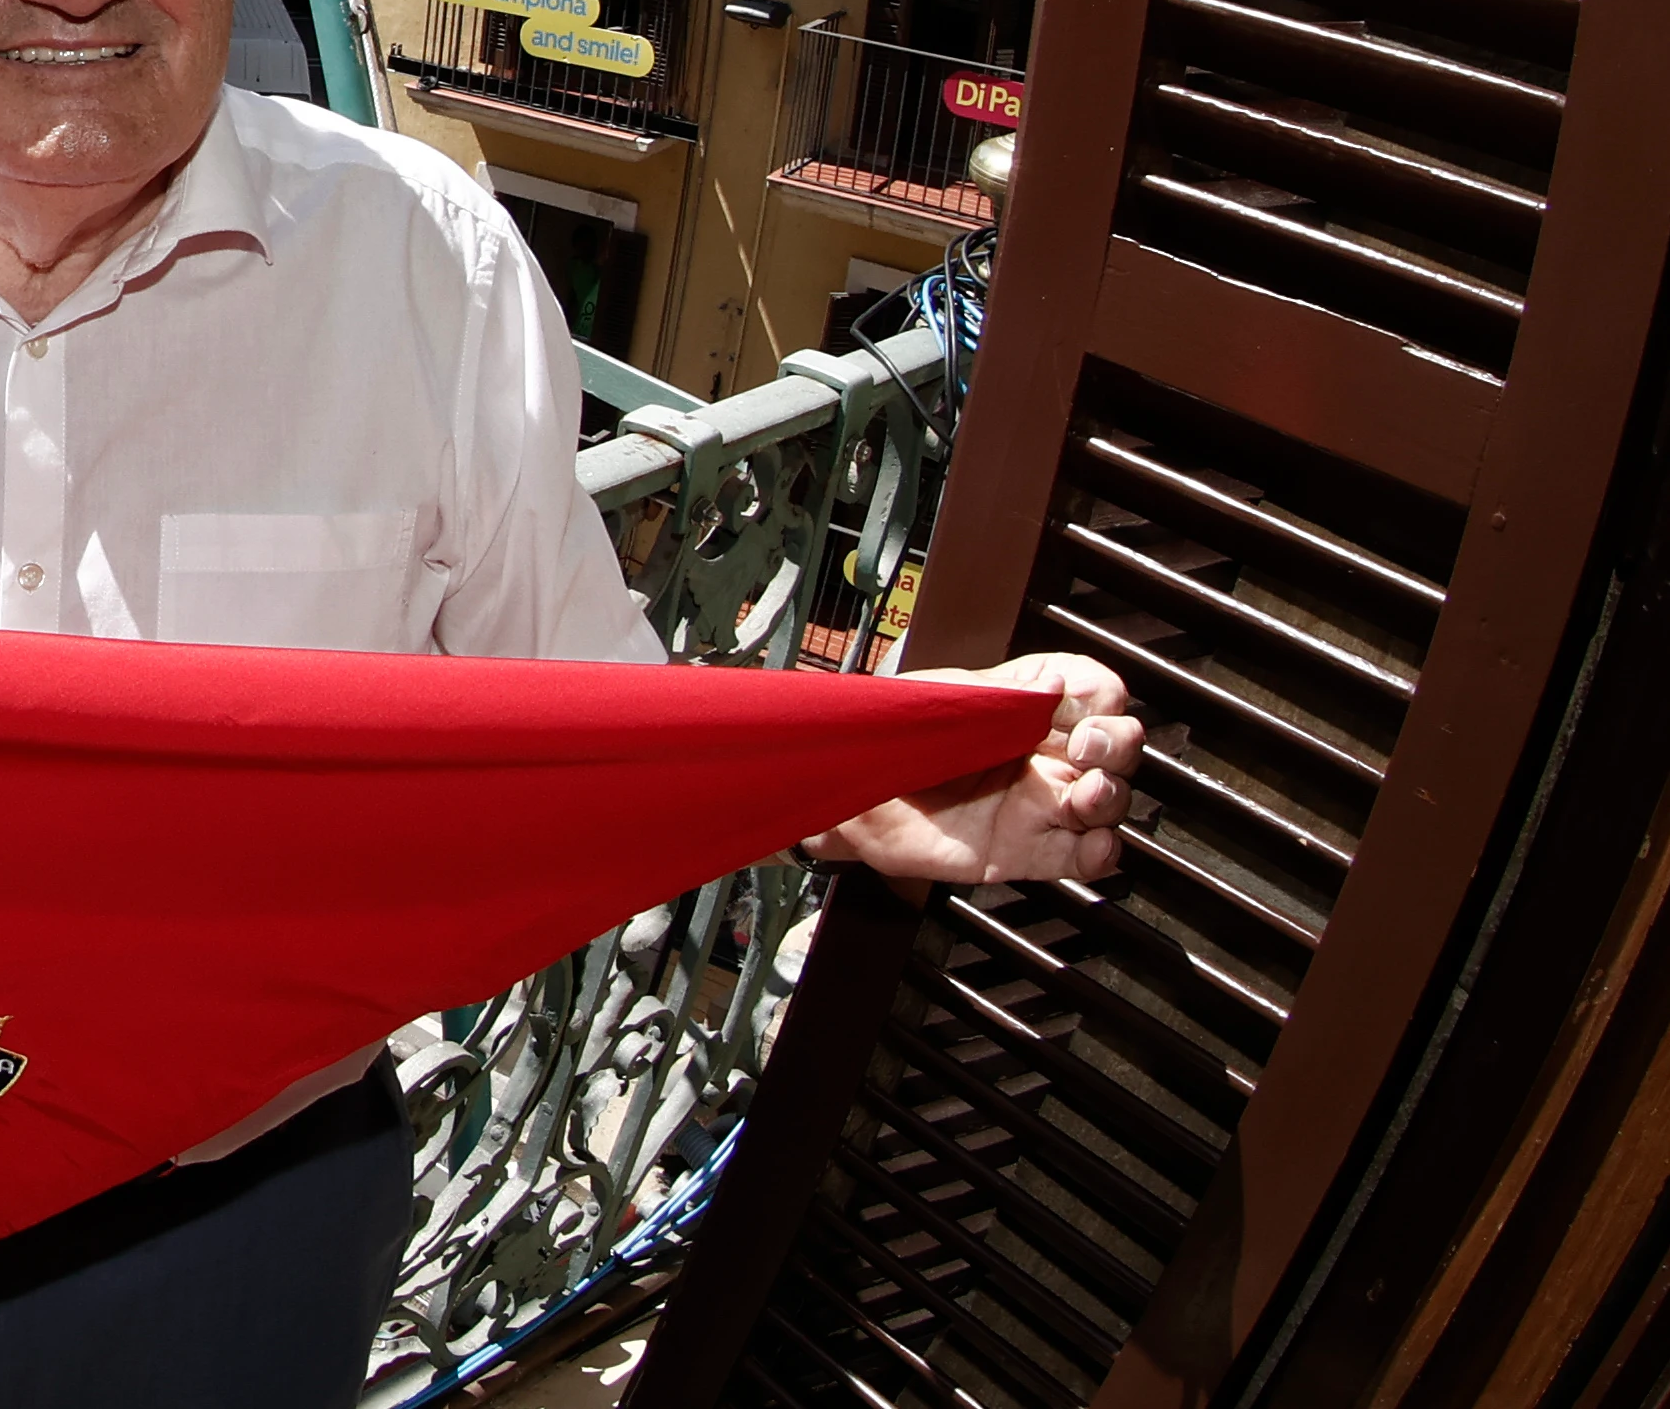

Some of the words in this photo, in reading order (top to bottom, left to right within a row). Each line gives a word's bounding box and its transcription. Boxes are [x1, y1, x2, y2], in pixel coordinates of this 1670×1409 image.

[531, 30, 574, 52] and
[577, 37, 640, 66] smile!
[955, 78, 987, 110] Di
